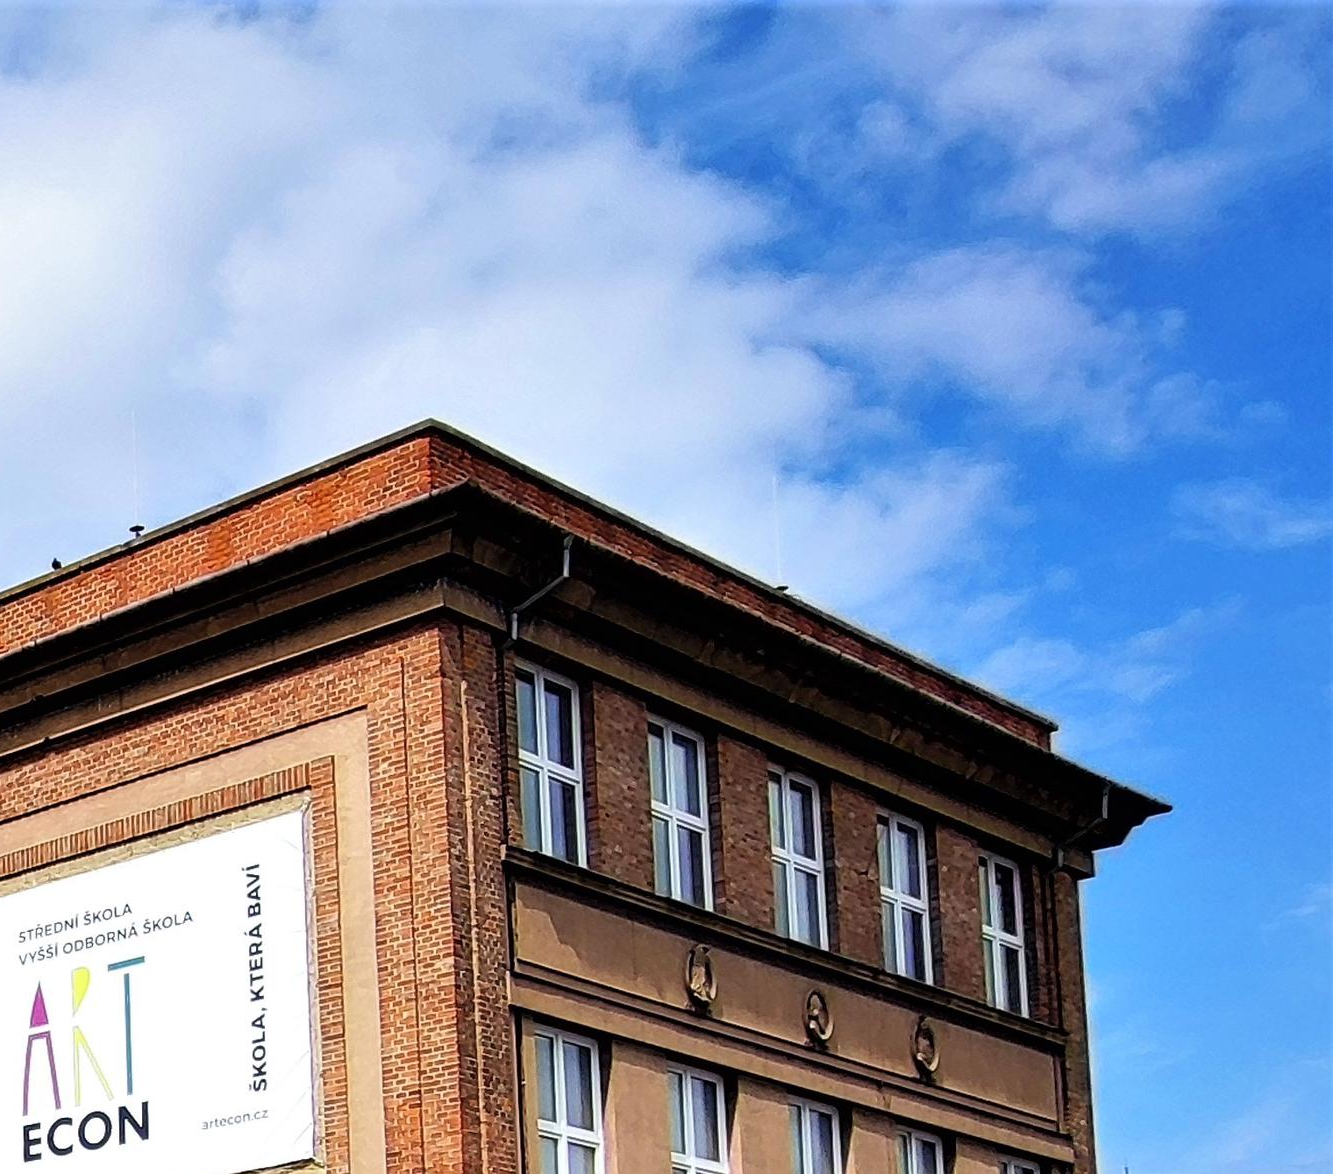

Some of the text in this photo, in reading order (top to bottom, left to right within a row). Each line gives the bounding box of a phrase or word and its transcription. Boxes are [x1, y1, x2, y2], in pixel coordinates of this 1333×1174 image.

[18, 903, 133, 944] STŘEDNÍ ŠKOLA
[18, 911, 194, 966] VYŠŠÍ ODBORNÁ ŠKOLA
[241, 863, 268, 1092] ŠKOLA, KTERÁ BAVÍ
[22, 955, 146, 1117] ART
[23, 1101, 150, 1163] ECON
[201, 1109, 269, 1130] artecon.cz
